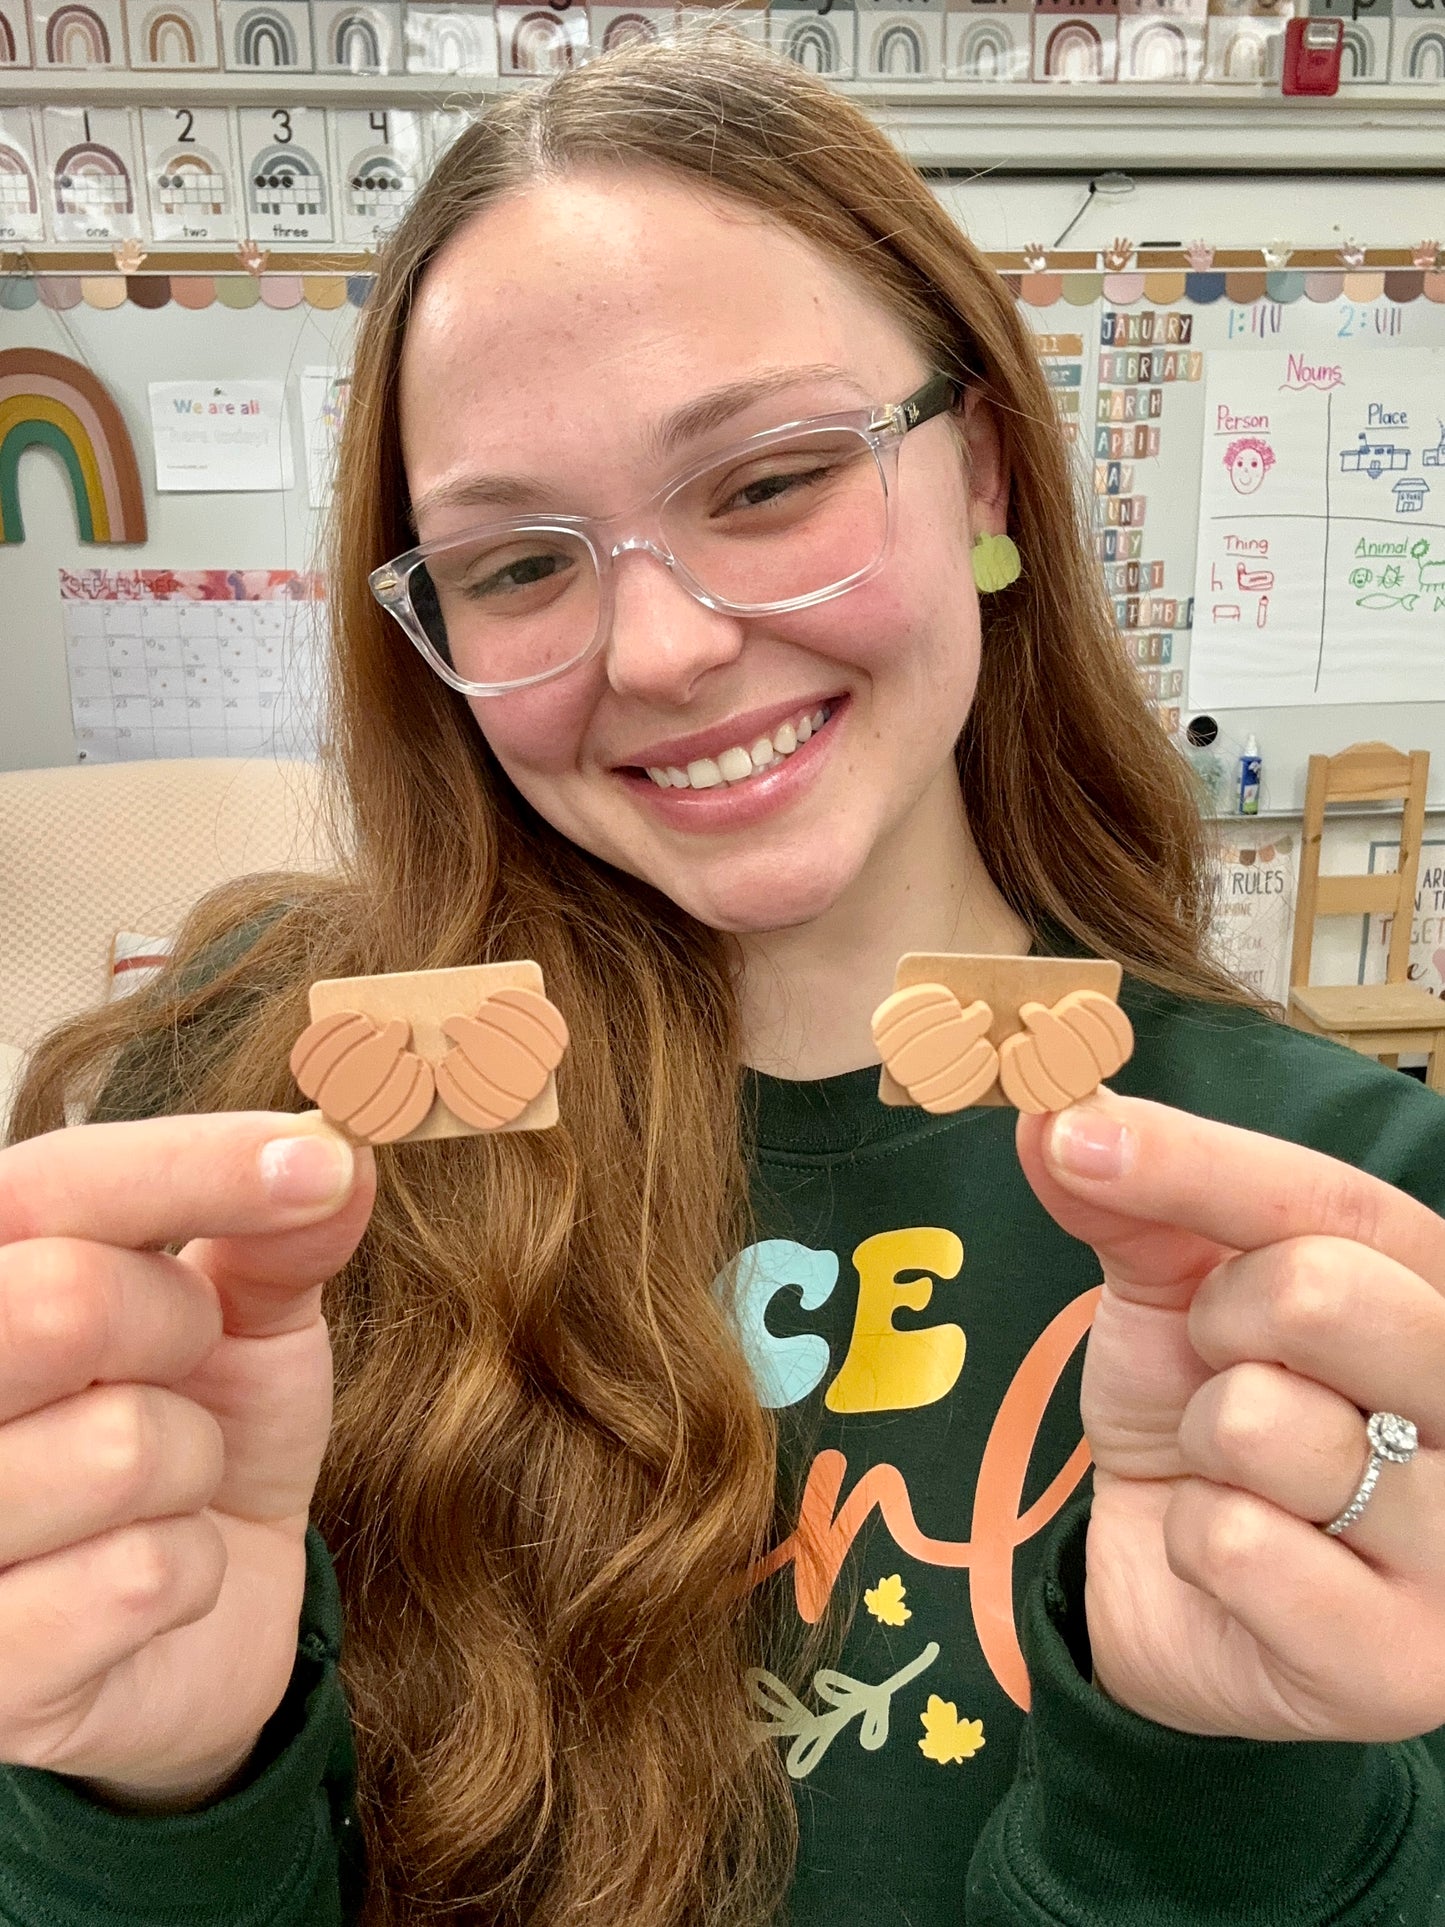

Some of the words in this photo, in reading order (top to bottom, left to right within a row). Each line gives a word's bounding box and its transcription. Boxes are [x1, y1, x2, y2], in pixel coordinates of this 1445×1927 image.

[175, 109, 196, 143] 2
[271, 109, 293, 144] 3
[369, 111, 390, 145] 4
[86, 227, 109, 237] one
[183, 225, 208, 237] two
[273, 224, 309, 237] three
[1101, 315, 1192, 343] JANUARY
[1101, 353, 1203, 380] FEBRUARY
[1287, 353, 1343, 384] Nouns
[173, 399, 203, 415] We
[208, 402, 235, 415] are
[240, 399, 260, 415] all
[1098, 391, 1162, 419] MARCH
[1217, 404, 1269, 431] Person
[1368, 402, 1408, 426] Place
[1096, 429, 1160, 455] APRIL
[1223, 535, 1268, 554] Thing
[1355, 537, 1408, 556] Animal
[1232, 871, 1284, 895] RULES
